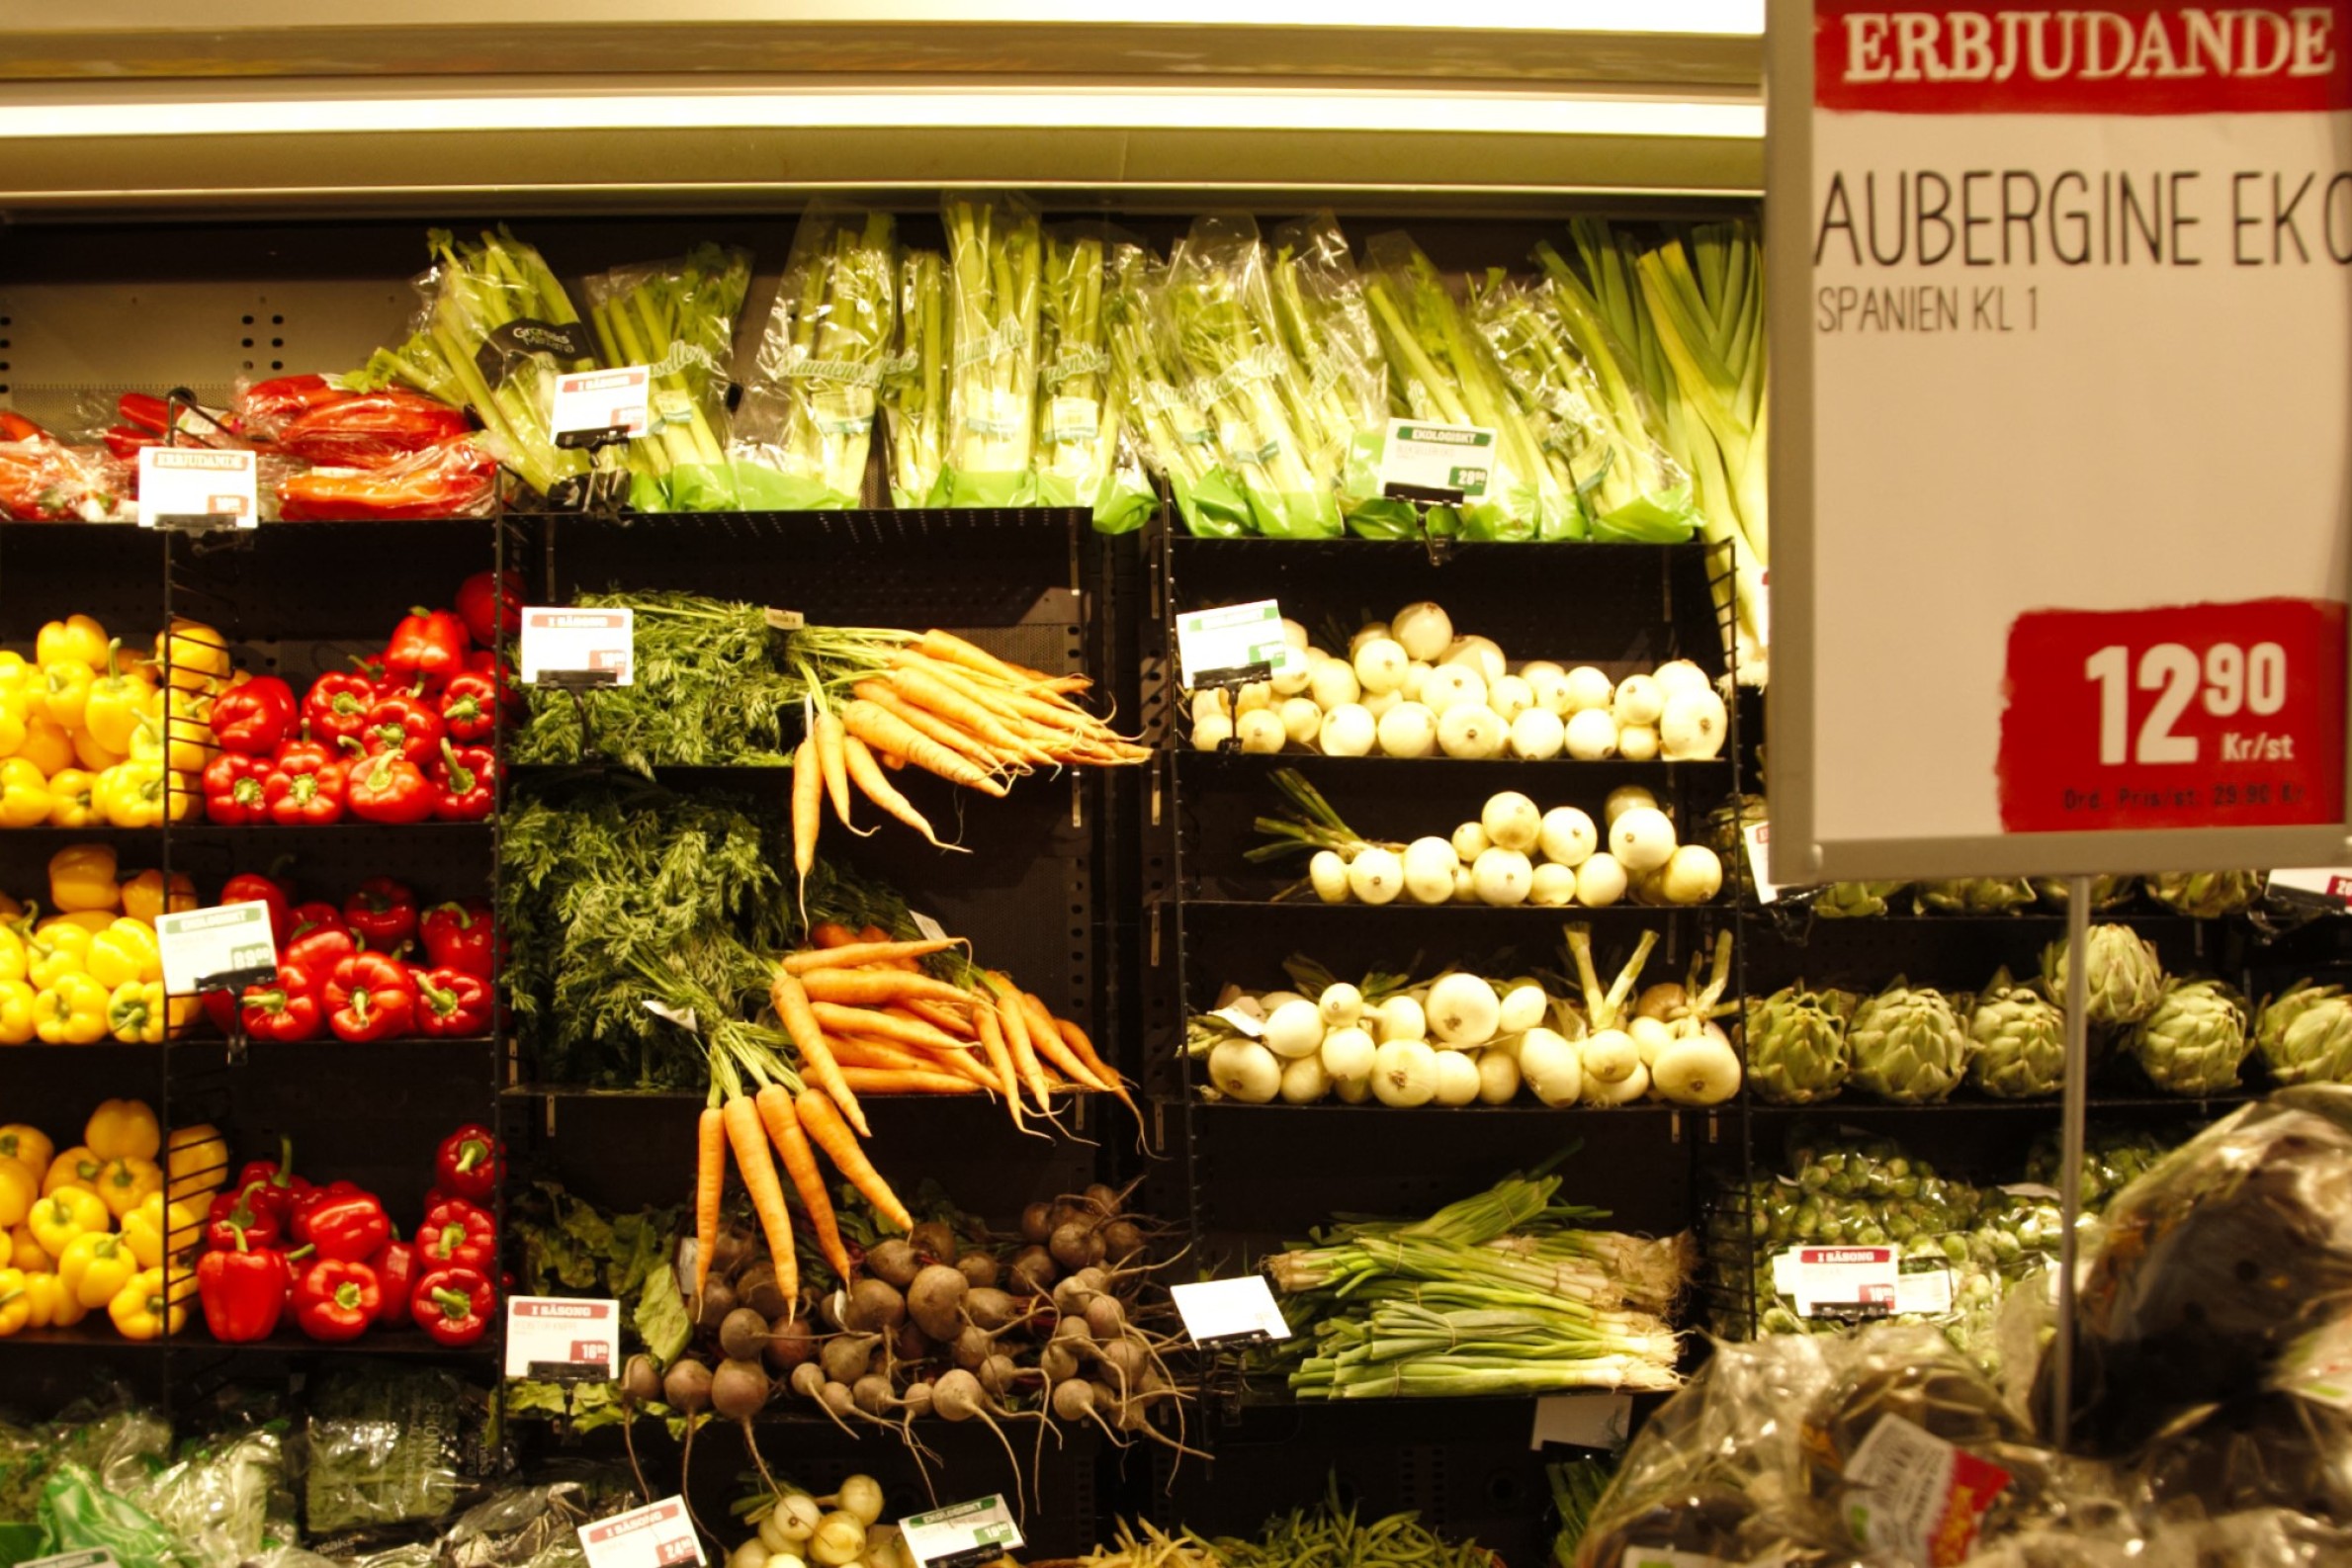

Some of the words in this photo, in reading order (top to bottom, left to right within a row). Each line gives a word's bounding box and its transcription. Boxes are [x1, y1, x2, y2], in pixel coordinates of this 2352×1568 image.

[1842, 8, 2336, 83] ERBJUDANDE
[1814, 170, 2203, 267] AUBERGINE
[1817, 286, 1959, 333] SPANIEN
[1973, 287, 2014, 332] KL
[2028, 286, 2040, 332] 1
[1411, 428, 1477, 445] EKOLOGISKT
[2221, 733, 2295, 762] Kr/st
